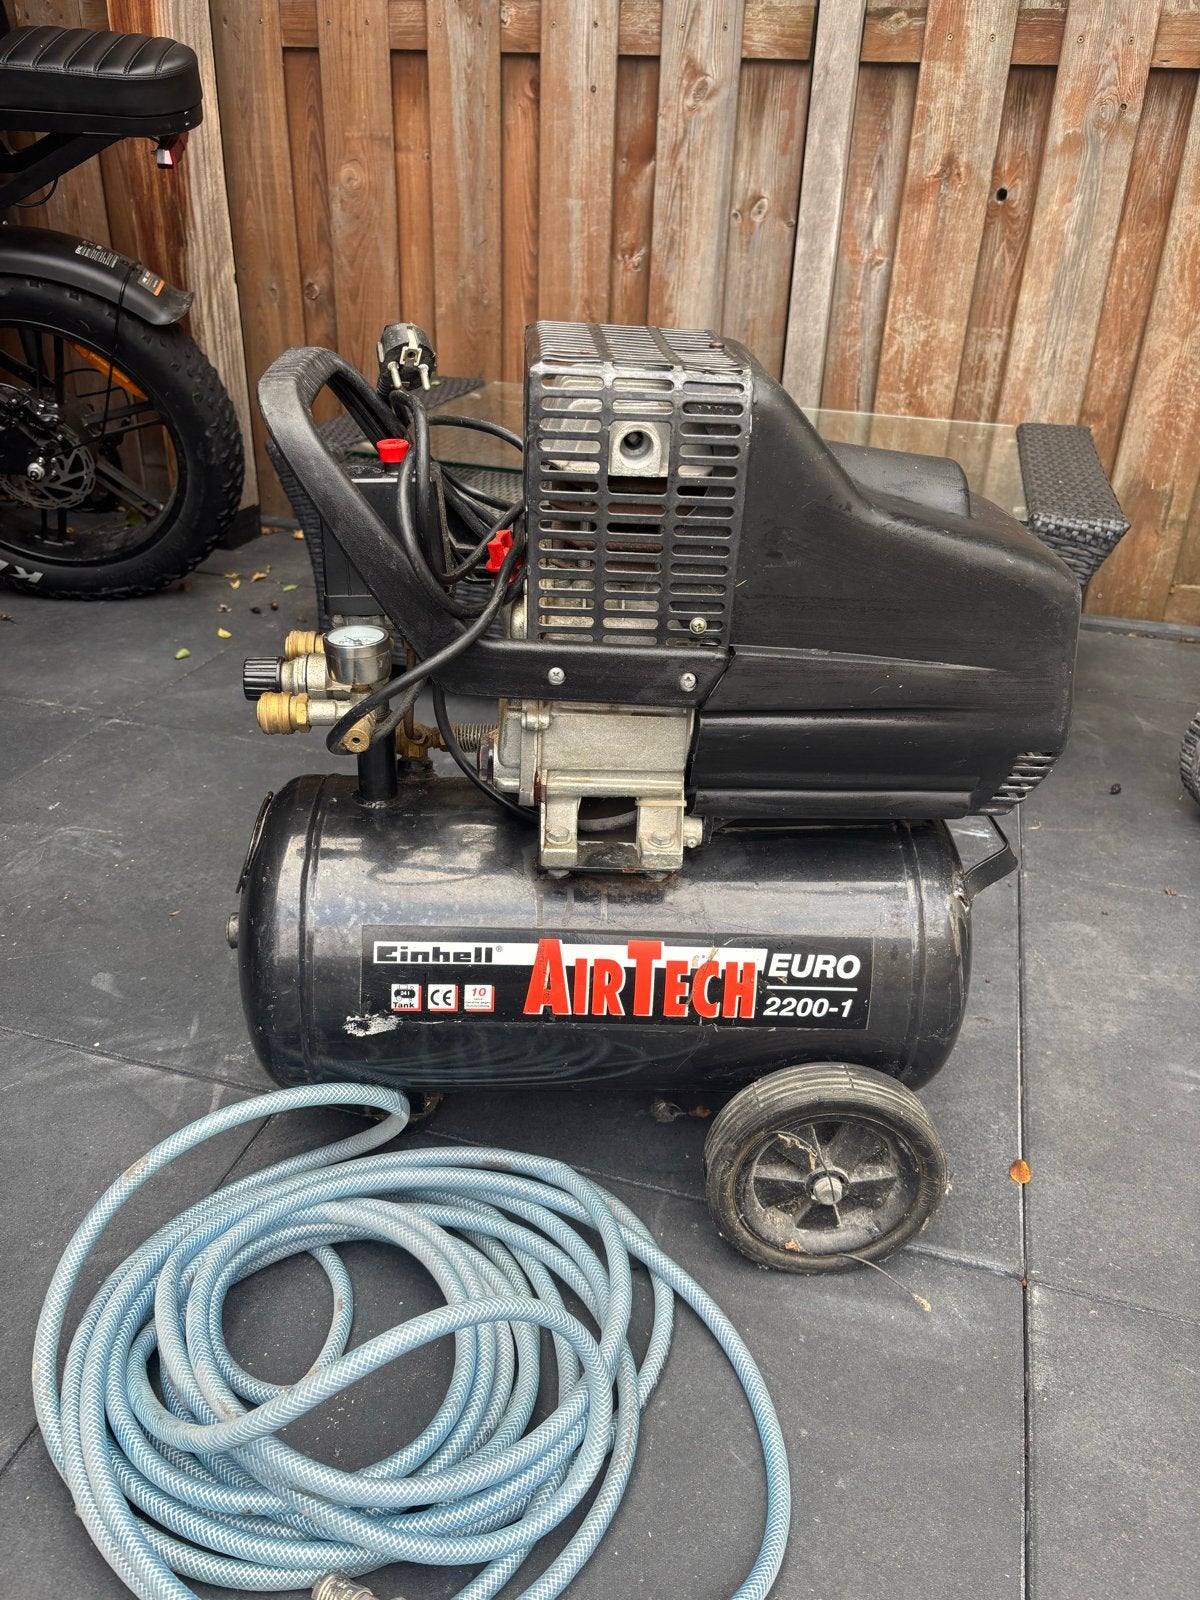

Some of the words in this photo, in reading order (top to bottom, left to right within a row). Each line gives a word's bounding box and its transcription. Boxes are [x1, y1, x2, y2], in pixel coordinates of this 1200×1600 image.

[768, 953, 861, 979] EURO
[430, 989, 452, 1006] CE
[472, 988, 486, 997] 10
[763, 997, 853, 1018] 2200-1
